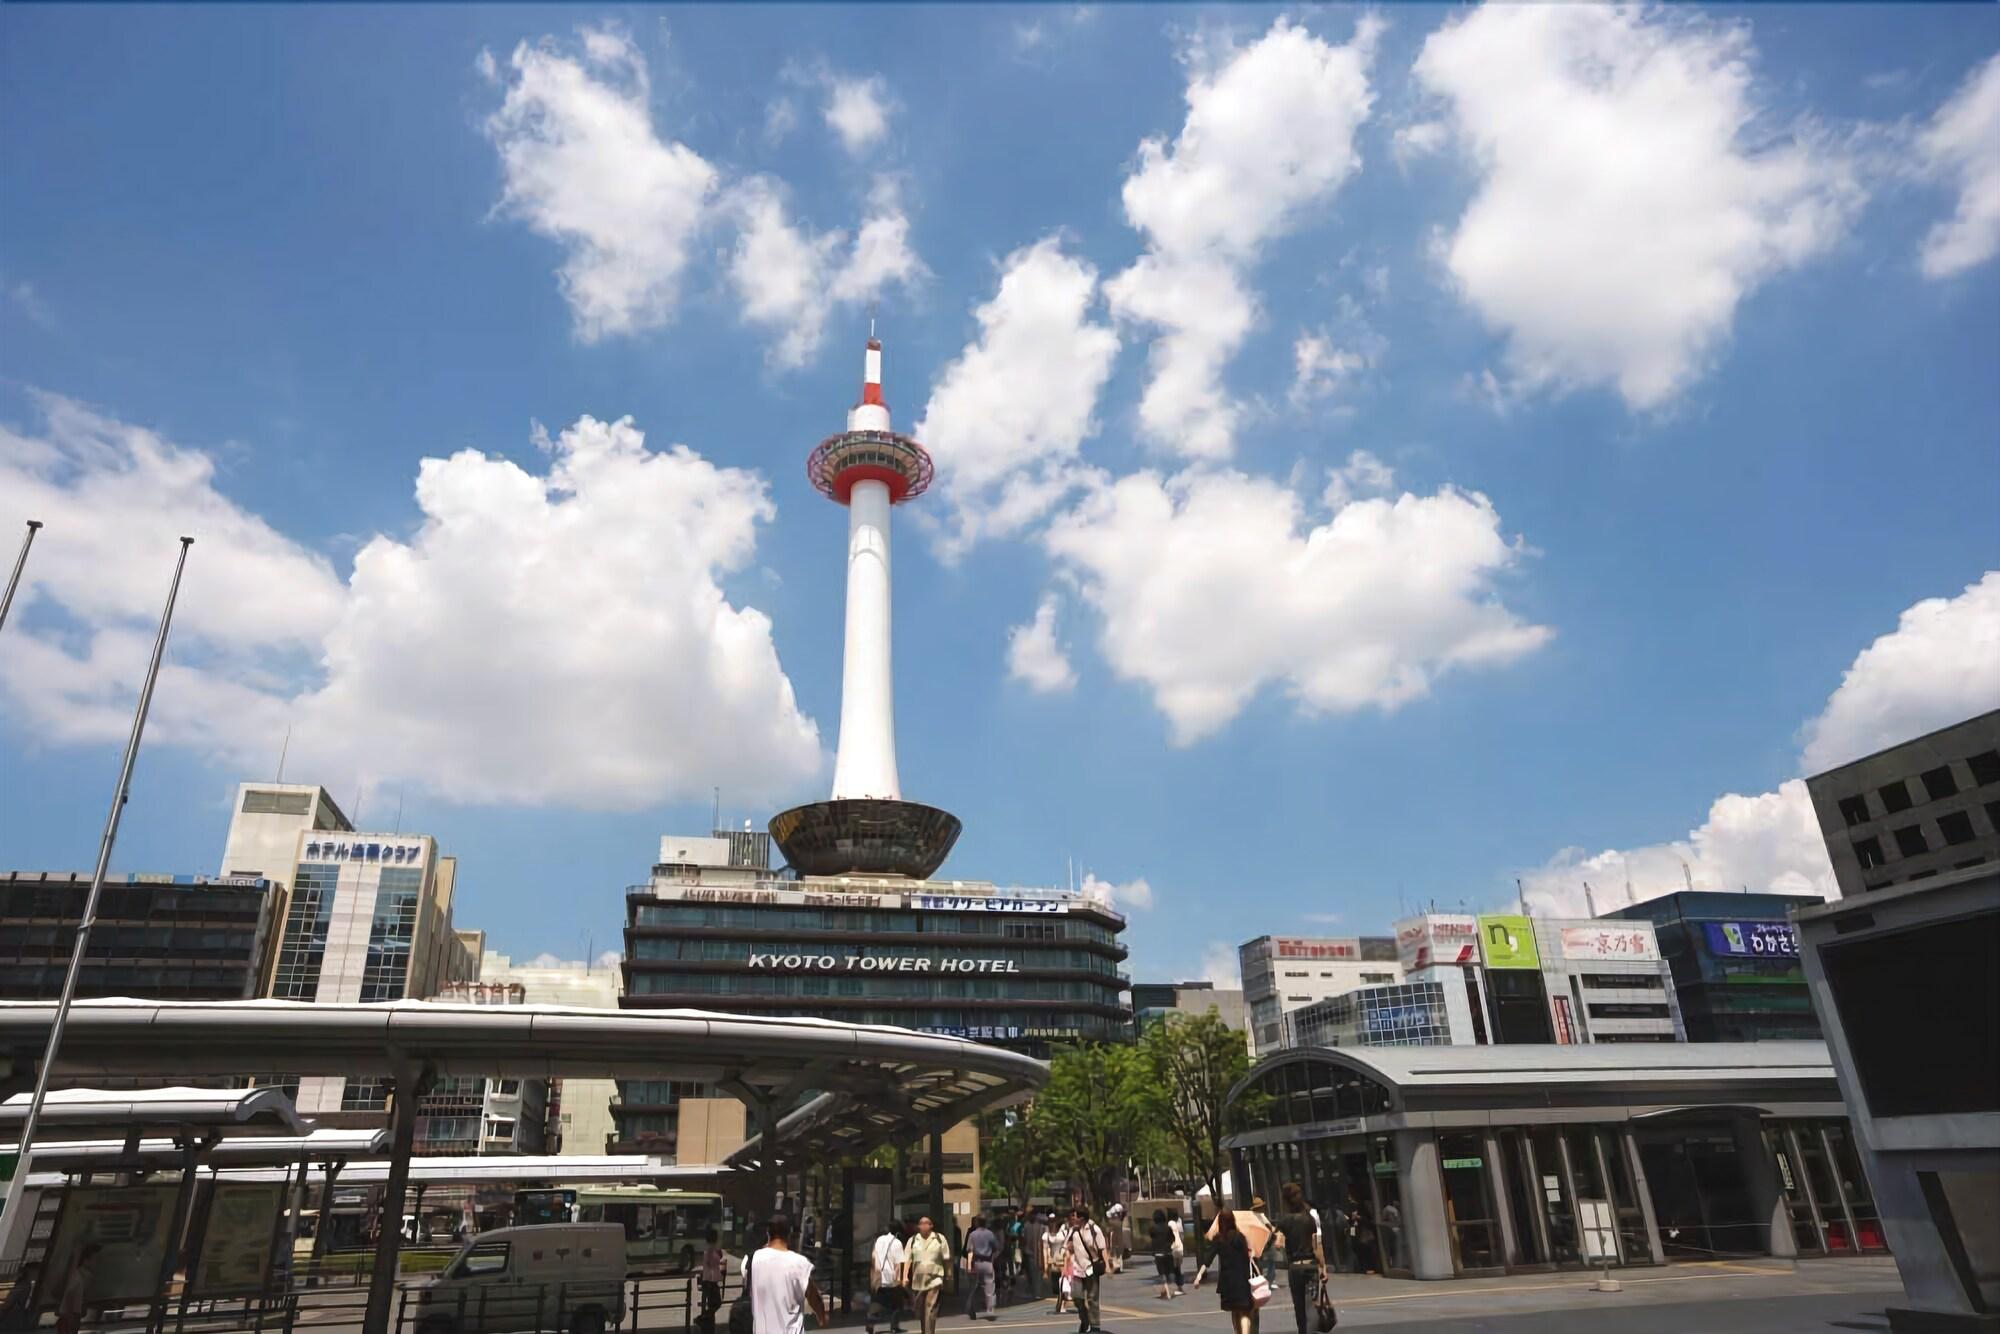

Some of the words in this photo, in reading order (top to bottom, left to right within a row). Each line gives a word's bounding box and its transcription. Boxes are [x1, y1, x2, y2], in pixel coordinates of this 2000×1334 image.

[748, 954, 836, 970] KYOTO
[843, 955, 932, 972] TOWER
[939, 958, 1020, 973] HOTEL
